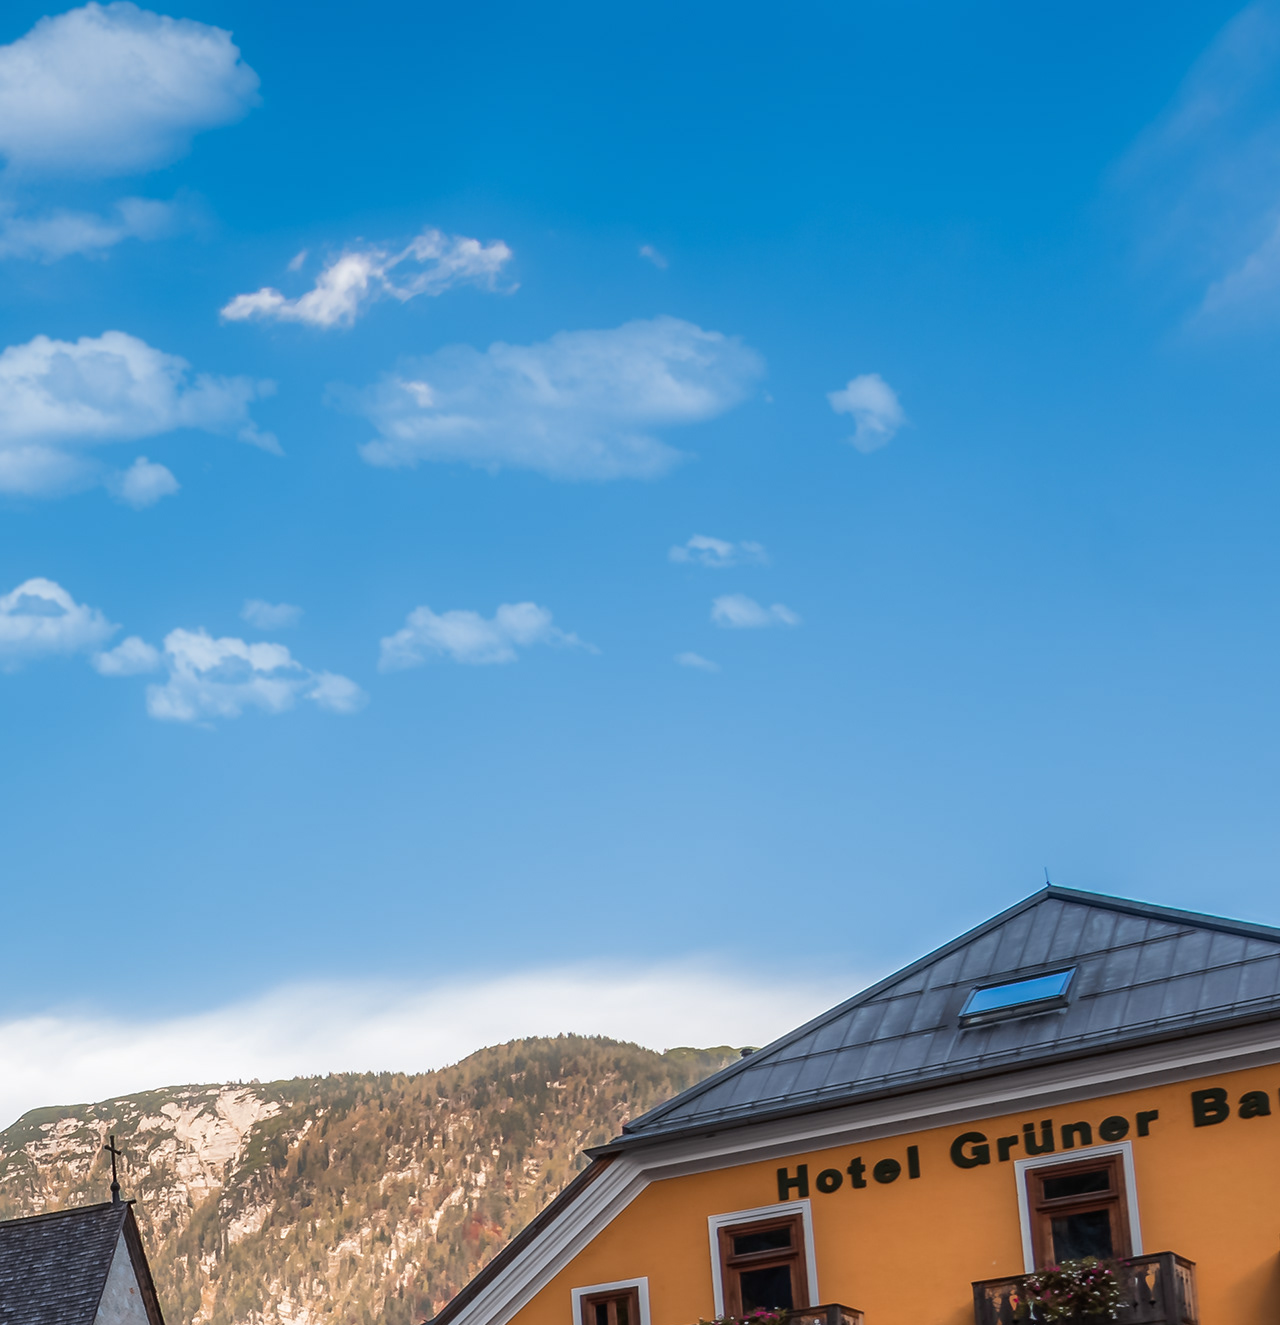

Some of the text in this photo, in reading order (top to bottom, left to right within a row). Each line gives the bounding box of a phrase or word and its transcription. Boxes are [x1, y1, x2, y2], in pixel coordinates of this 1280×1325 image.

[776, 1087, 1280, 1201] Hotel Grüner Ba
